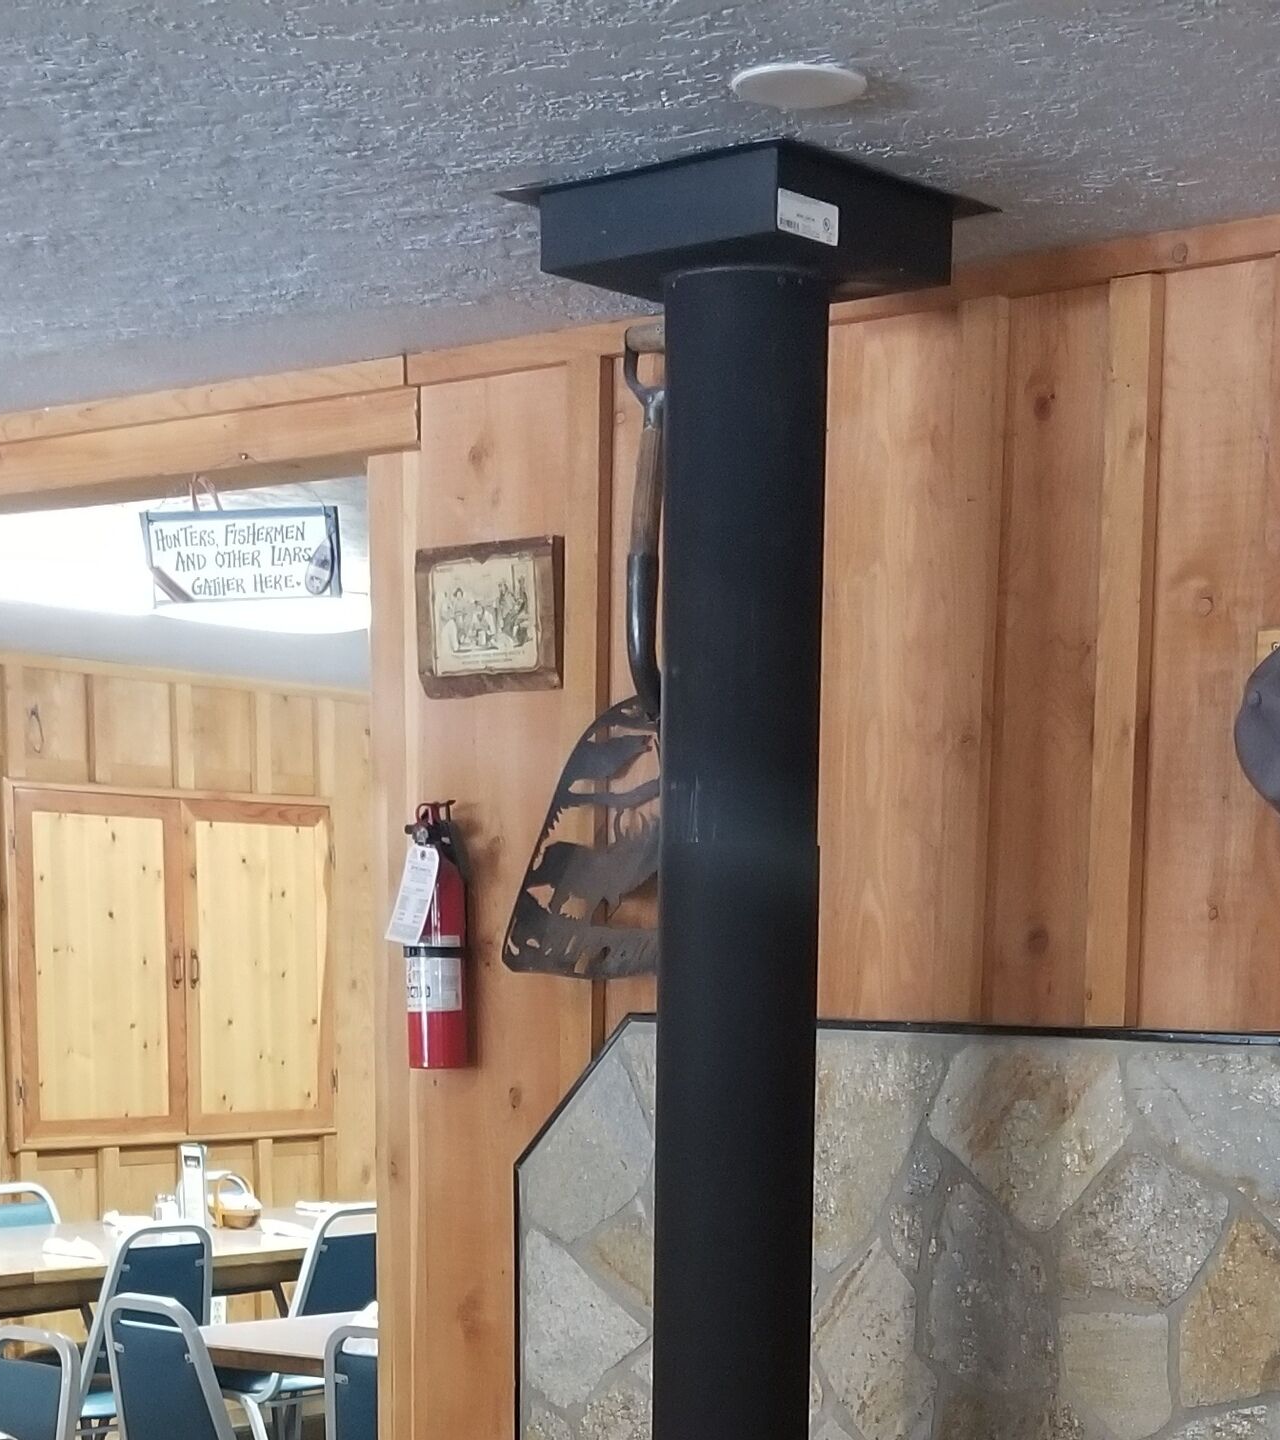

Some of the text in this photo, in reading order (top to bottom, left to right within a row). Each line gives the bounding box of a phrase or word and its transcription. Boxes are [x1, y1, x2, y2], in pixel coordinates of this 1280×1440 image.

[155, 521, 305, 551] HUNTERS, FISHERMEN
[175, 547, 312, 572] AND OTHER LIARS
[191, 574, 246, 597] GATHER
